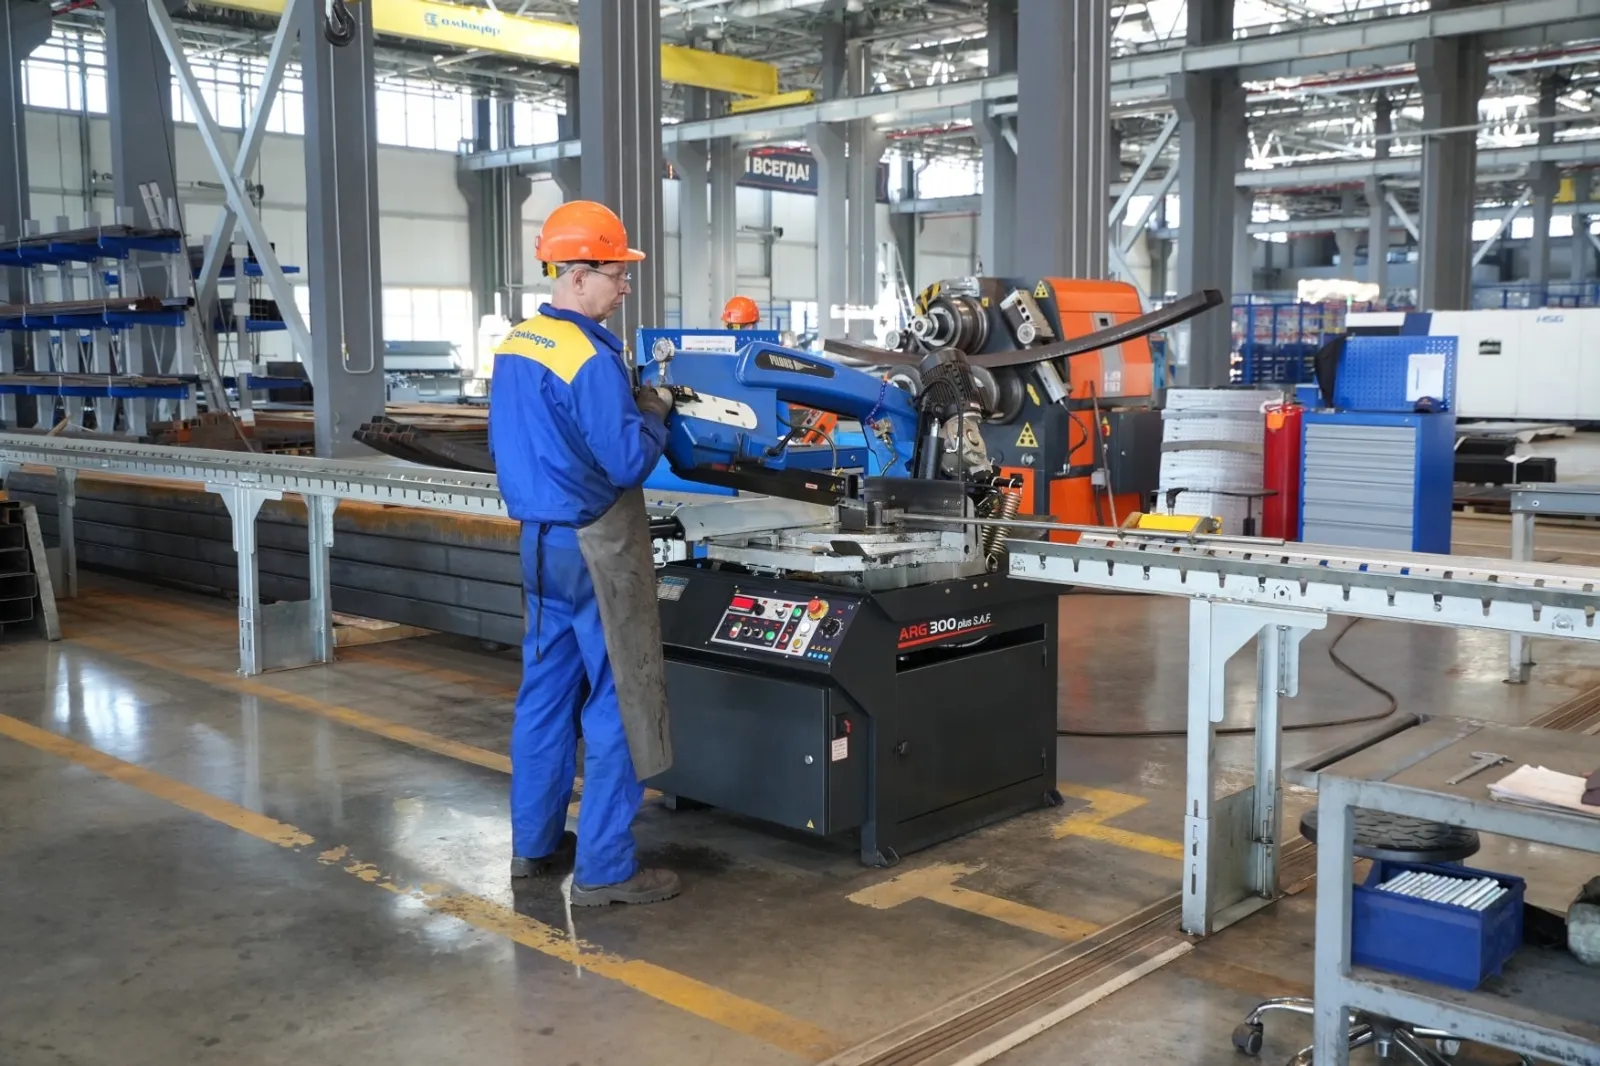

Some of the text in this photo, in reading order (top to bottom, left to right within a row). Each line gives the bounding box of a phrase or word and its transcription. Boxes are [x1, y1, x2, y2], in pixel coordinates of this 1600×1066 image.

[753, 157, 809, 183] ВСЕГДА!
[899, 612, 992, 641] ARG 300 plus S.A.F.
